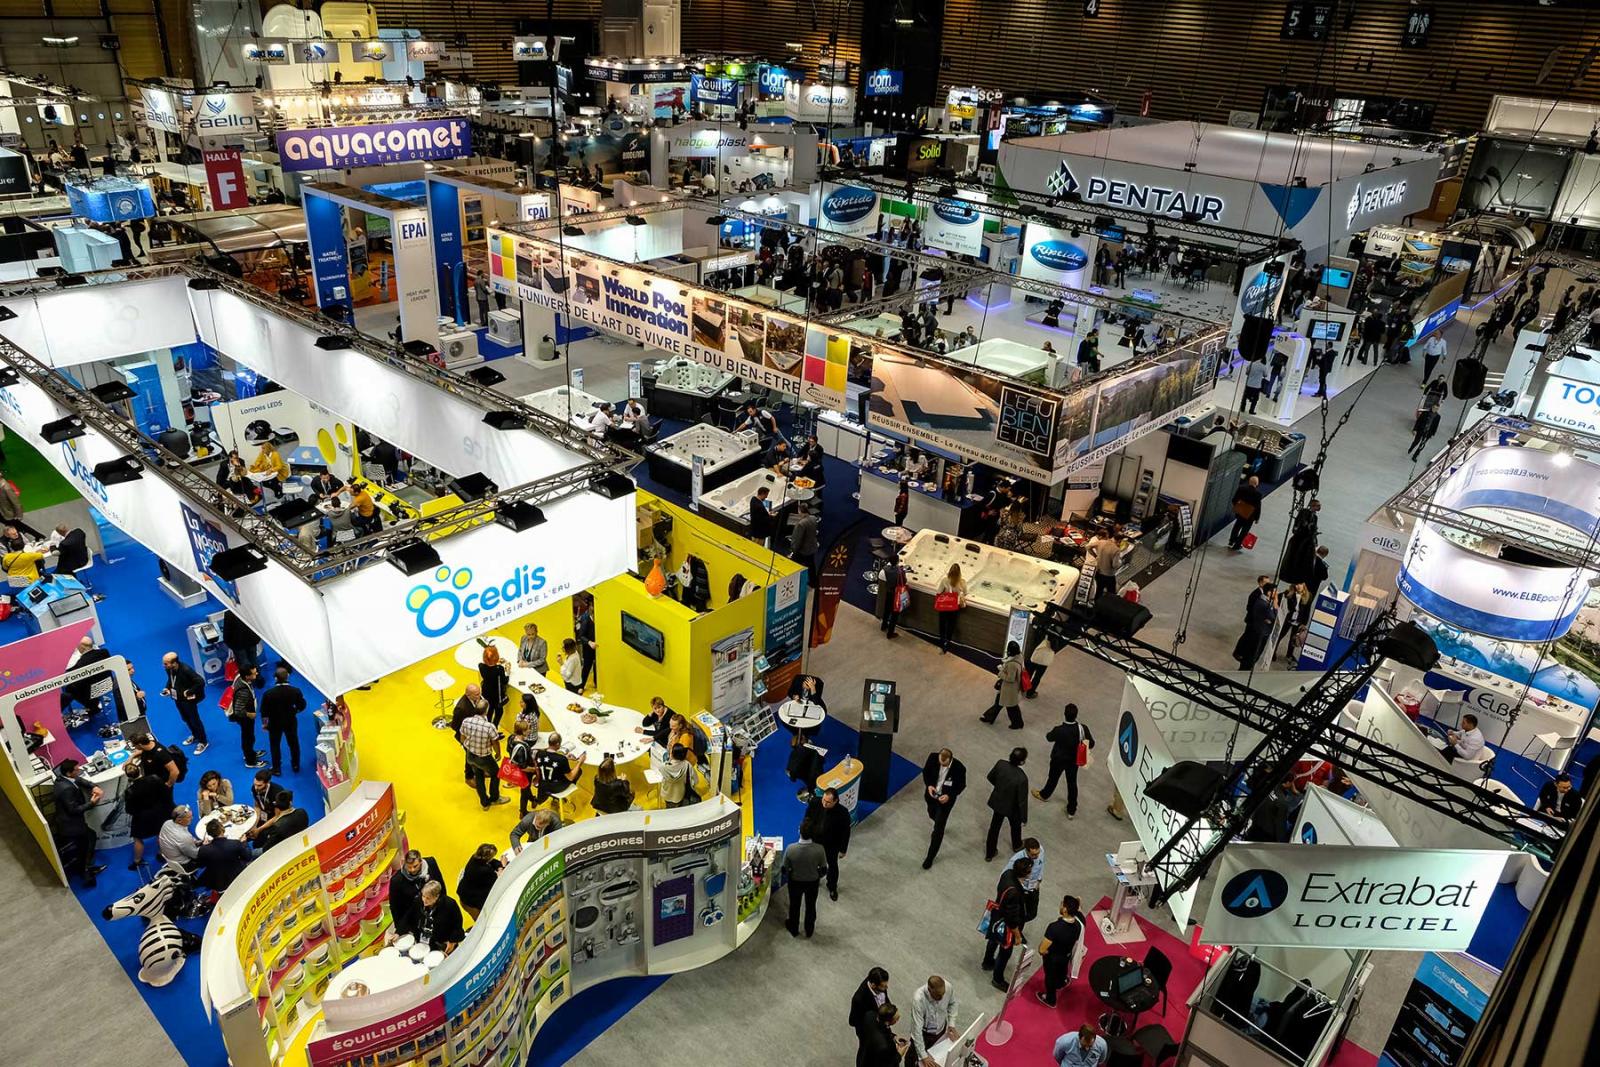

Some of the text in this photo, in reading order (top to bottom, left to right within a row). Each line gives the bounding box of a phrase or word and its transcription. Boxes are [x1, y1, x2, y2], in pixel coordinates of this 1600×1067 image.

[1288, 10, 1298, 26] 5
[697, 78, 732, 92] AQUILUS
[869, 72, 891, 87] dom
[811, 95, 846, 104] Rexair
[146, 111, 177, 126] aello
[199, 114, 253, 129] aello
[206, 151, 239, 162] HALL 4
[335, 148, 463, 165] FEEL THE QUALITY
[919, 143, 942, 160] Solid
[475, 166, 513, 175] ENCLOSURES
[217, 172, 237, 205] F
[1087, 178, 1223, 221] PENTAIR
[1361, 181, 1407, 213] PENTAIR
[827, 195, 873, 209] Riptide
[605, 294, 689, 337] Innovation
[518, 287, 801, 396] L'UNIVERS DE L'ART DE VIVRE ET DU BIEN-ETRE
[1004, 390, 1052, 418] L'EAU
[1002, 406, 1050, 436] BIEN
[1537, 412, 1596, 431] FLUIDRA
[901, 424, 940, 444] ENSEMBLE
[944, 440, 953, 448] Le
[980, 452, 998, 464] actif
[999, 458, 1009, 467] de
[1010, 462, 1017, 470] la
[1019, 466, 1047, 480] piscine
[1096, 436, 1128, 459] ENSEMBLE
[1372, 535, 1400, 549] elite
[416, 564, 547, 638] Ocedis
[465, 582, 571, 632] LE PLAISIR DE L'EAU
[15, 664, 105, 701] Laboratoire d'analyses
[657, 819, 733, 845] ACCESSOIRES
[565, 836, 644, 862] ACCESSOIRES
[1300, 872, 1478, 908] Extrabat
[1293, 914, 1458, 931] LOGICIEL
[465, 932, 511, 990] PROTÉGER
[332, 1010, 428, 1052] ÉQUILIBRER
